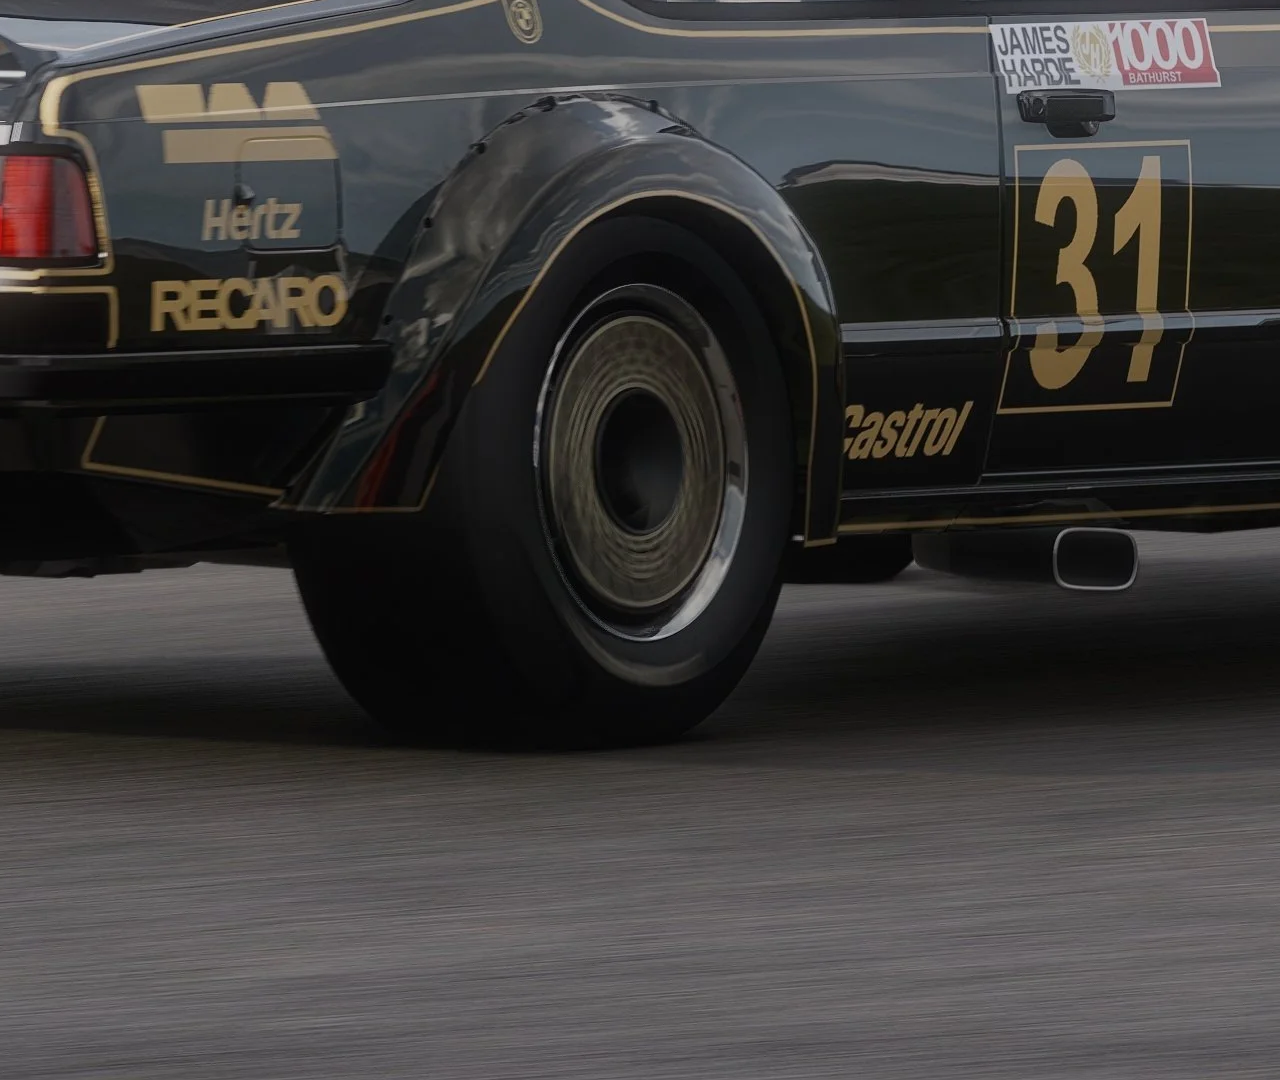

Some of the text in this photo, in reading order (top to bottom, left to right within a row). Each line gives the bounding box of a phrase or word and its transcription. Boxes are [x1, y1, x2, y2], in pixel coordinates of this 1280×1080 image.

[997, 24, 1070, 57] JAMES
[1107, 21, 1204, 71] 1000
[1002, 57, 1082, 88] HARDIE
[1128, 71, 1183, 84] BATHURST
[200, 197, 304, 242] Hertz
[1028, 155, 1163, 391] 31
[150, 274, 349, 333] RECARO
